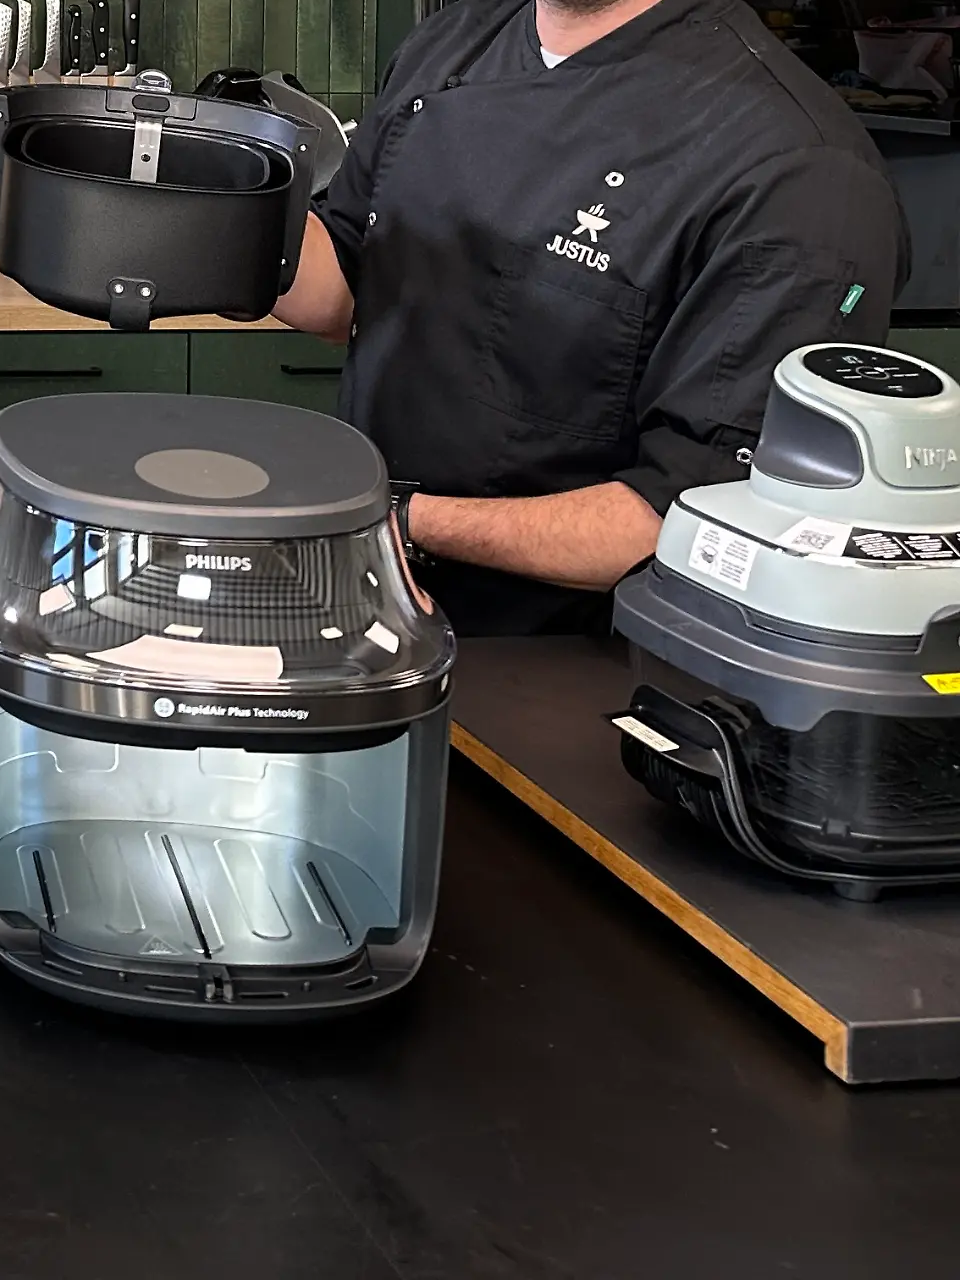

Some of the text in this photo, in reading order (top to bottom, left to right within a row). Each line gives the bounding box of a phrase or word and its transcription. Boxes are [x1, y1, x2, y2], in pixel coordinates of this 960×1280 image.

[546, 234, 611, 271] JUSTUS
[904, 445, 958, 471] NINJA
[185, 553, 252, 572] PHILIPS
[178, 703, 310, 720] RapidAir Plus Technology
